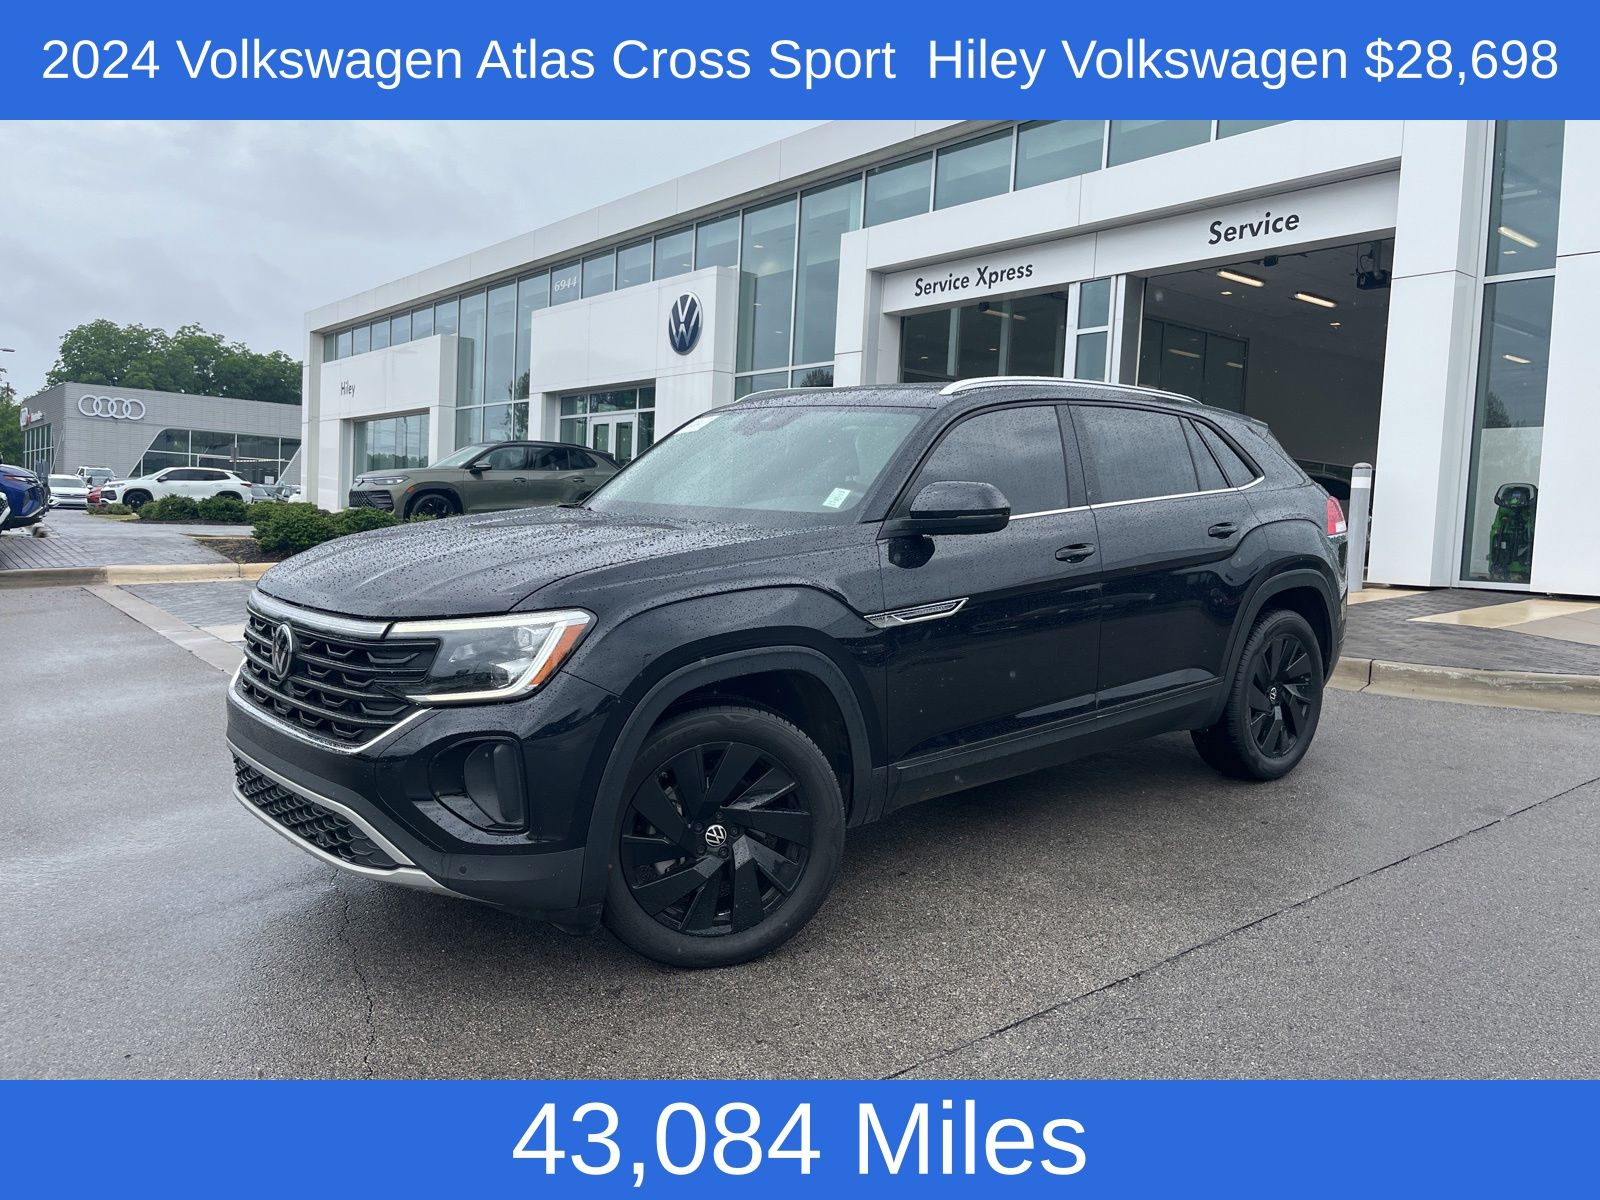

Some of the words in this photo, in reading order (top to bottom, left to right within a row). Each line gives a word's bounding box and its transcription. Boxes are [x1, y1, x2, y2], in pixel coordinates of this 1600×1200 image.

[1208, 211, 1300, 245] Service
[554, 276, 577, 292] 6944
[914, 272, 970, 297] Service
[975, 263, 1034, 290] Xpress
[340, 380, 356, 398] Hiley
